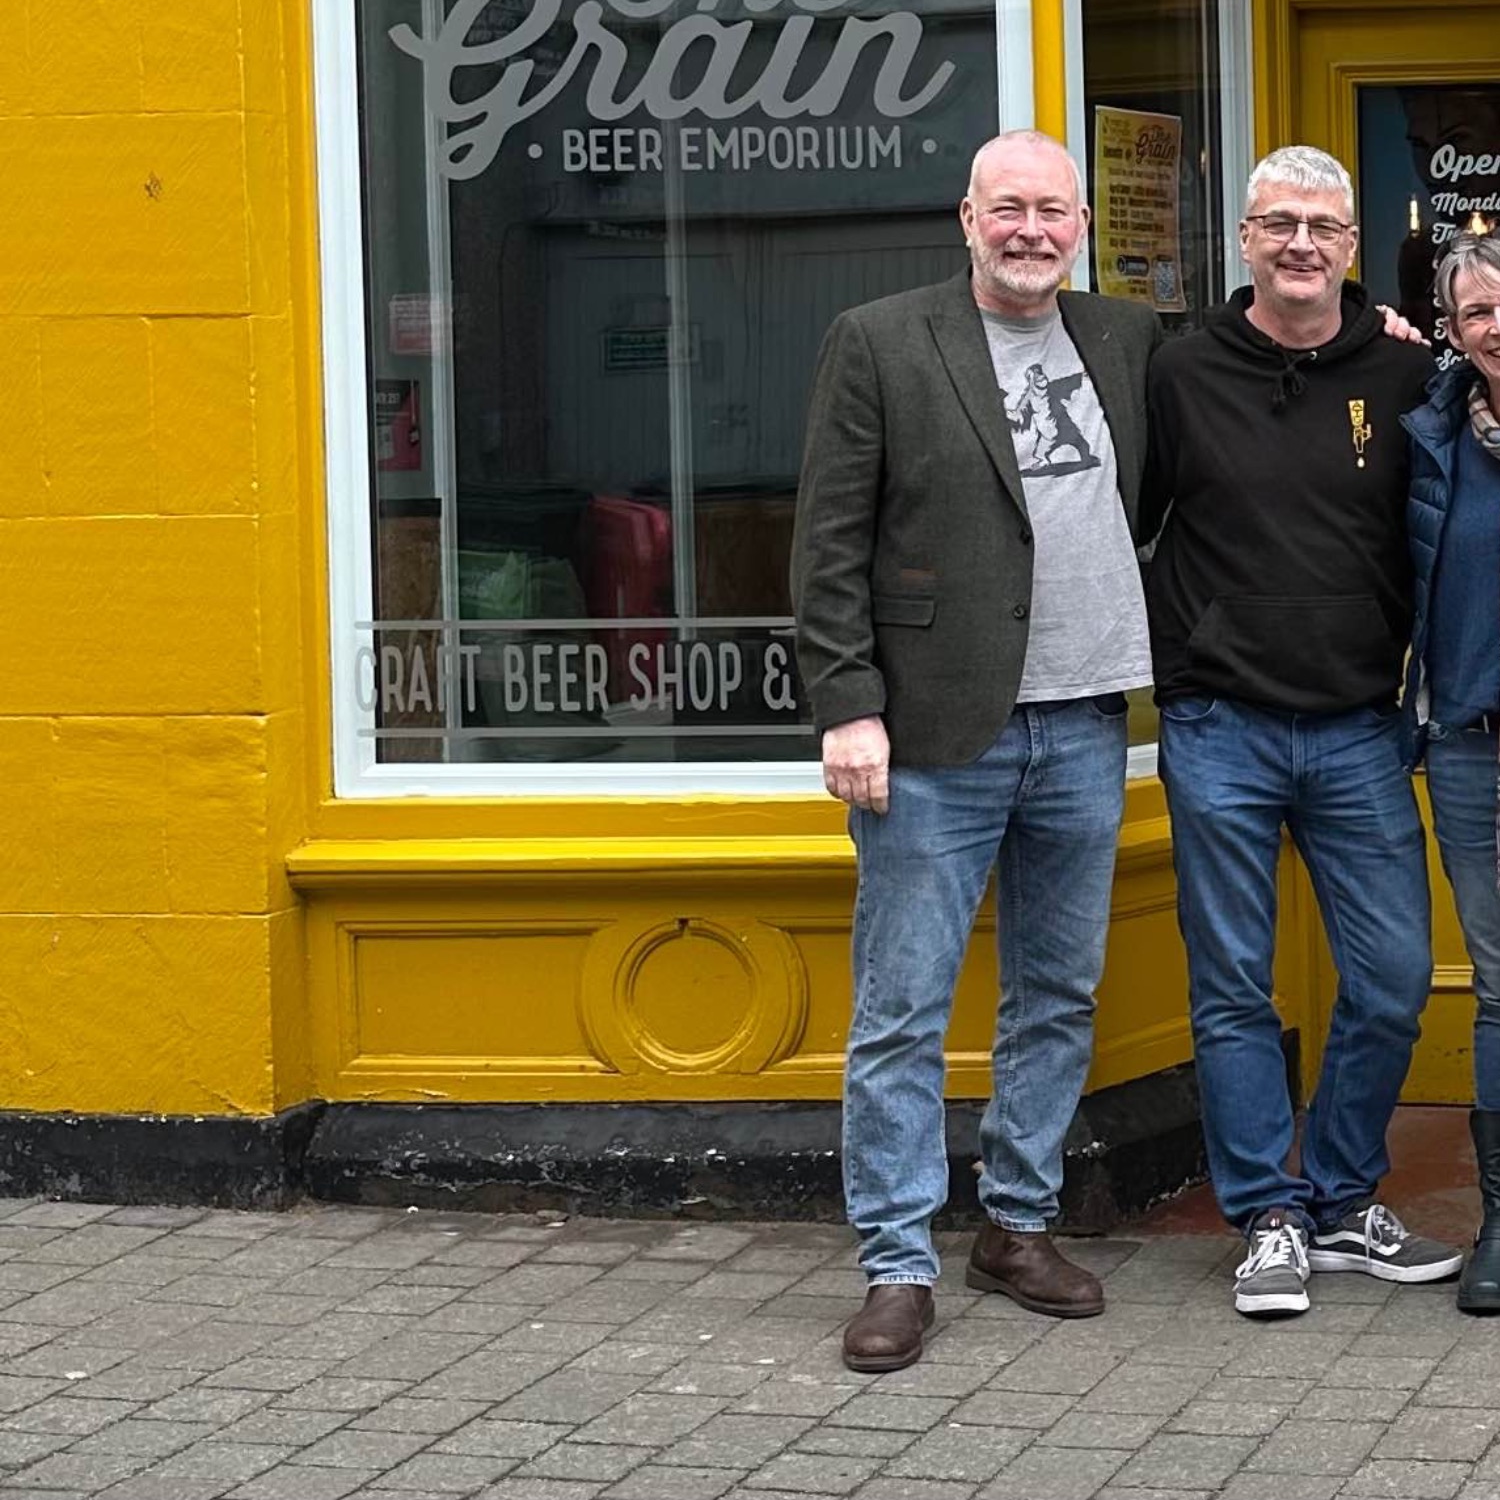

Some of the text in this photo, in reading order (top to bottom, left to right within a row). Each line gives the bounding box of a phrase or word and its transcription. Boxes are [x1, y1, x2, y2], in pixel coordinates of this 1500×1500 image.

[562, 125, 902, 173] BEER EMPORIUM
[354, 642, 797, 714] CRAFT BEER SHOP &
